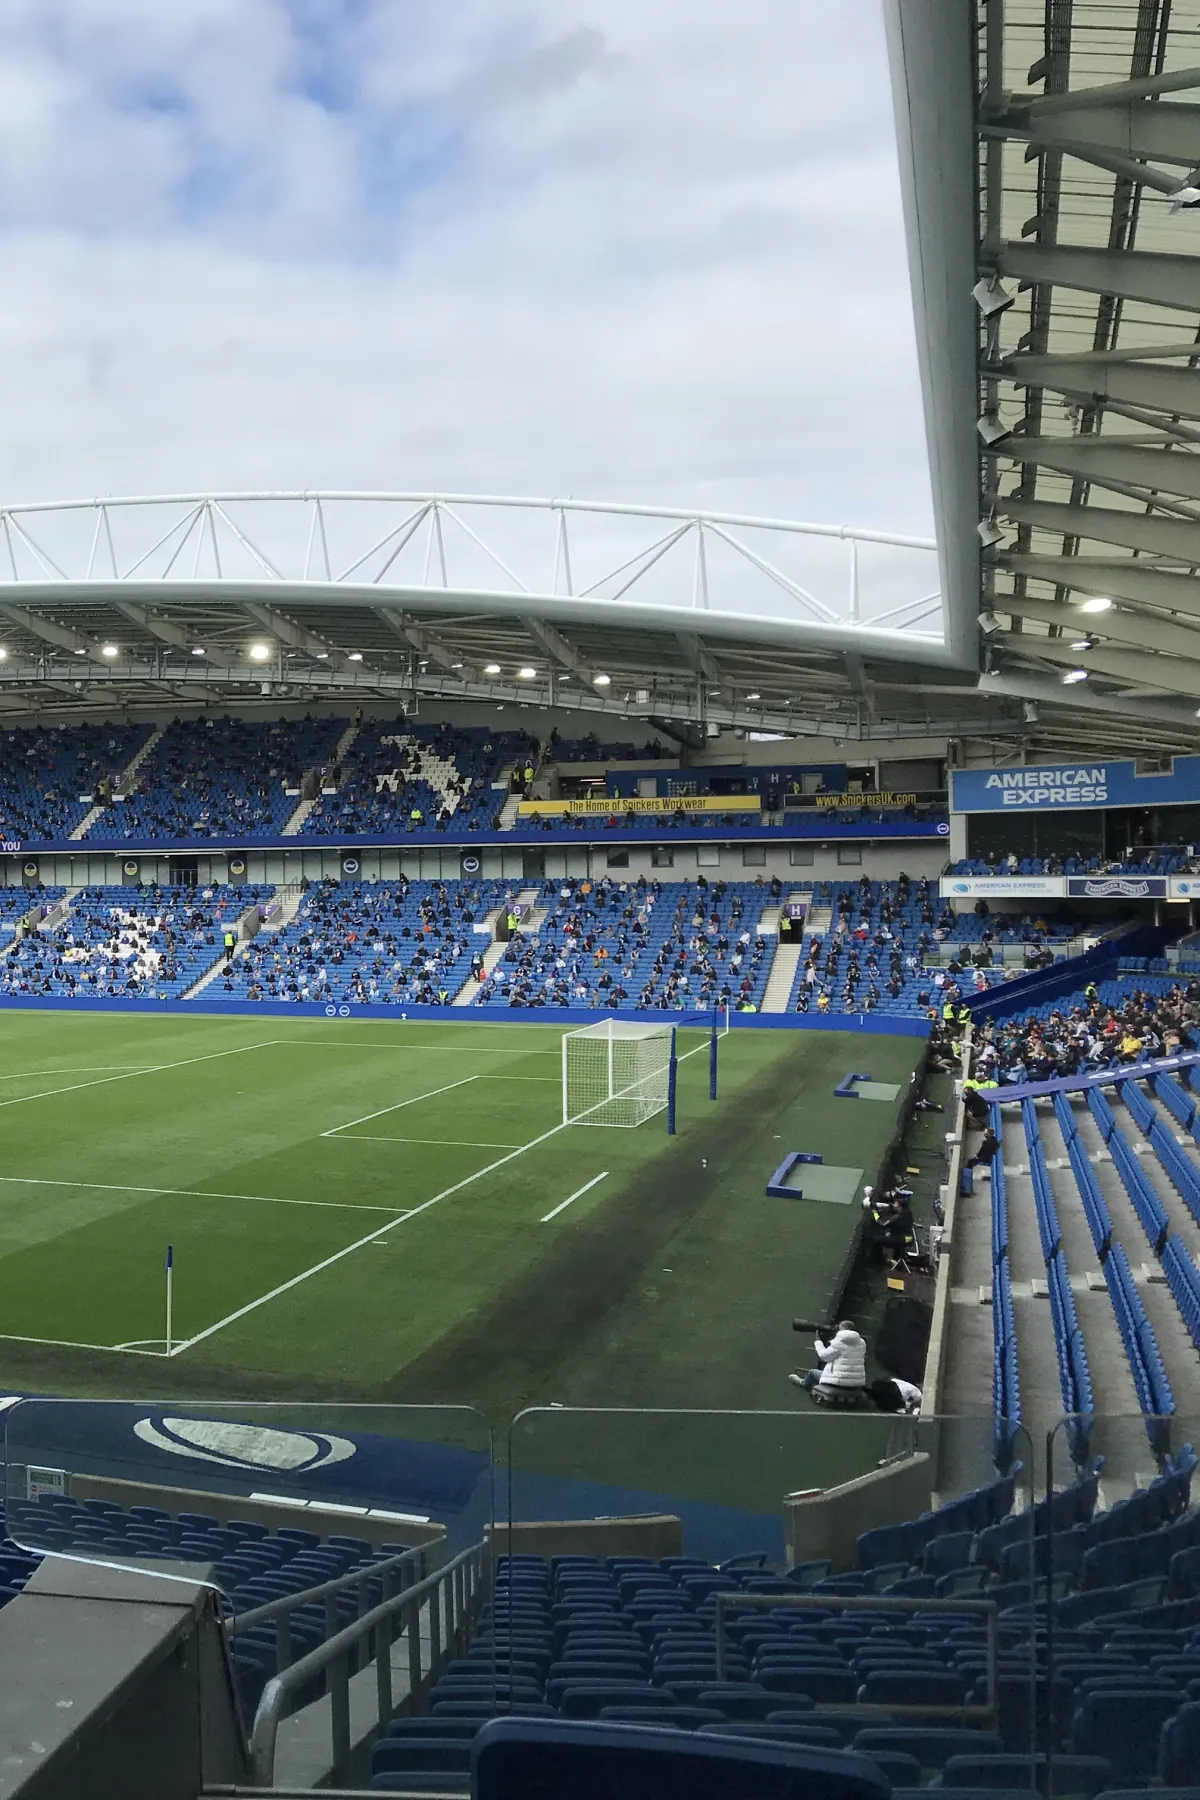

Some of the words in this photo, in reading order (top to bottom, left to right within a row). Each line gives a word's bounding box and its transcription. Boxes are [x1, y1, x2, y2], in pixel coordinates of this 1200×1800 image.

[771, 773, 779, 783] H
[986, 768, 1106, 789] AMERICAN
[815, 792, 917, 807] www.SnickersUK.com
[1003, 786, 1108, 805] EXPRESS
[569, 800, 584, 812] The
[585, 800, 610, 811] Home
[611, 799, 620, 811] of
[662, 797, 707, 810] Workwear
[1, 841, 21, 851] YOU
[46, 905, 53, 914] E
[265, 905, 272, 915] F
[513, 905, 521, 915] G
[791, 905, 800, 916] H
